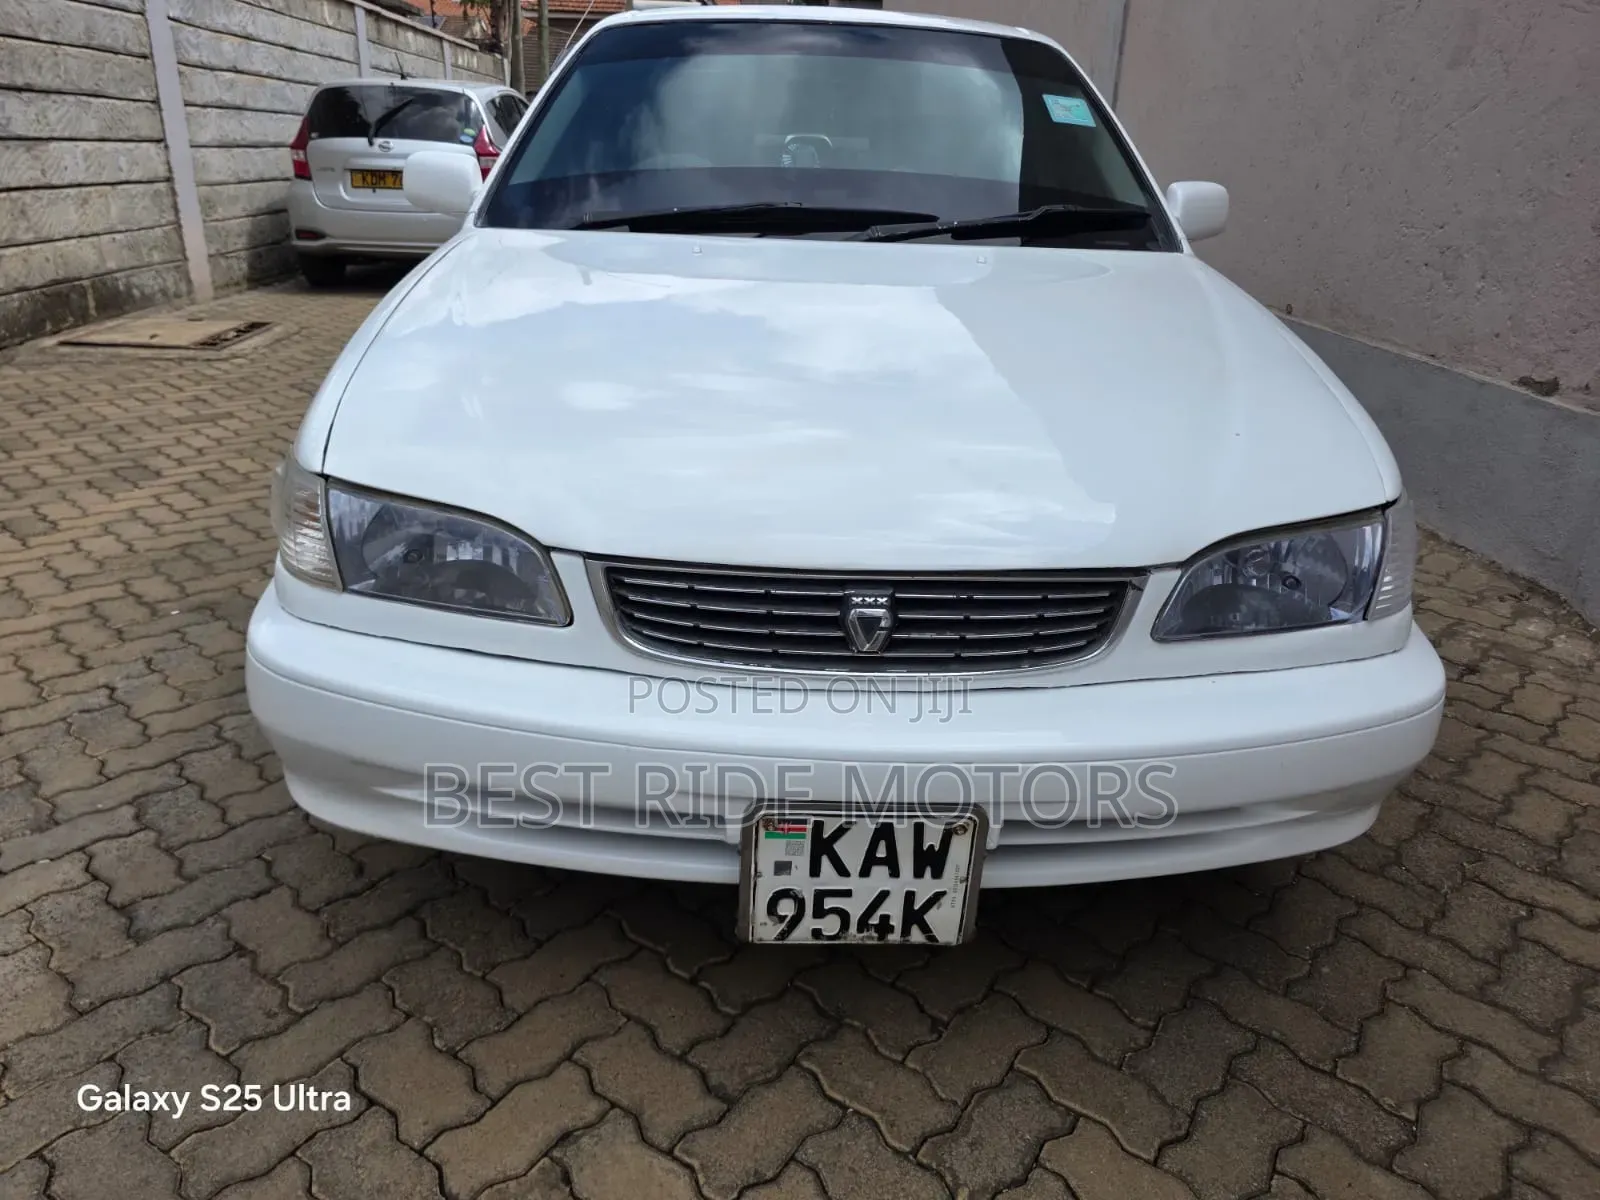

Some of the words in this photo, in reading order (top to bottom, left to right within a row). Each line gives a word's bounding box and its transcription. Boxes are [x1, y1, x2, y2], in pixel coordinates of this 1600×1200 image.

[392, 172, 403, 187] 7
[809, 820, 957, 880] KAW
[766, 888, 948, 943] 954K
